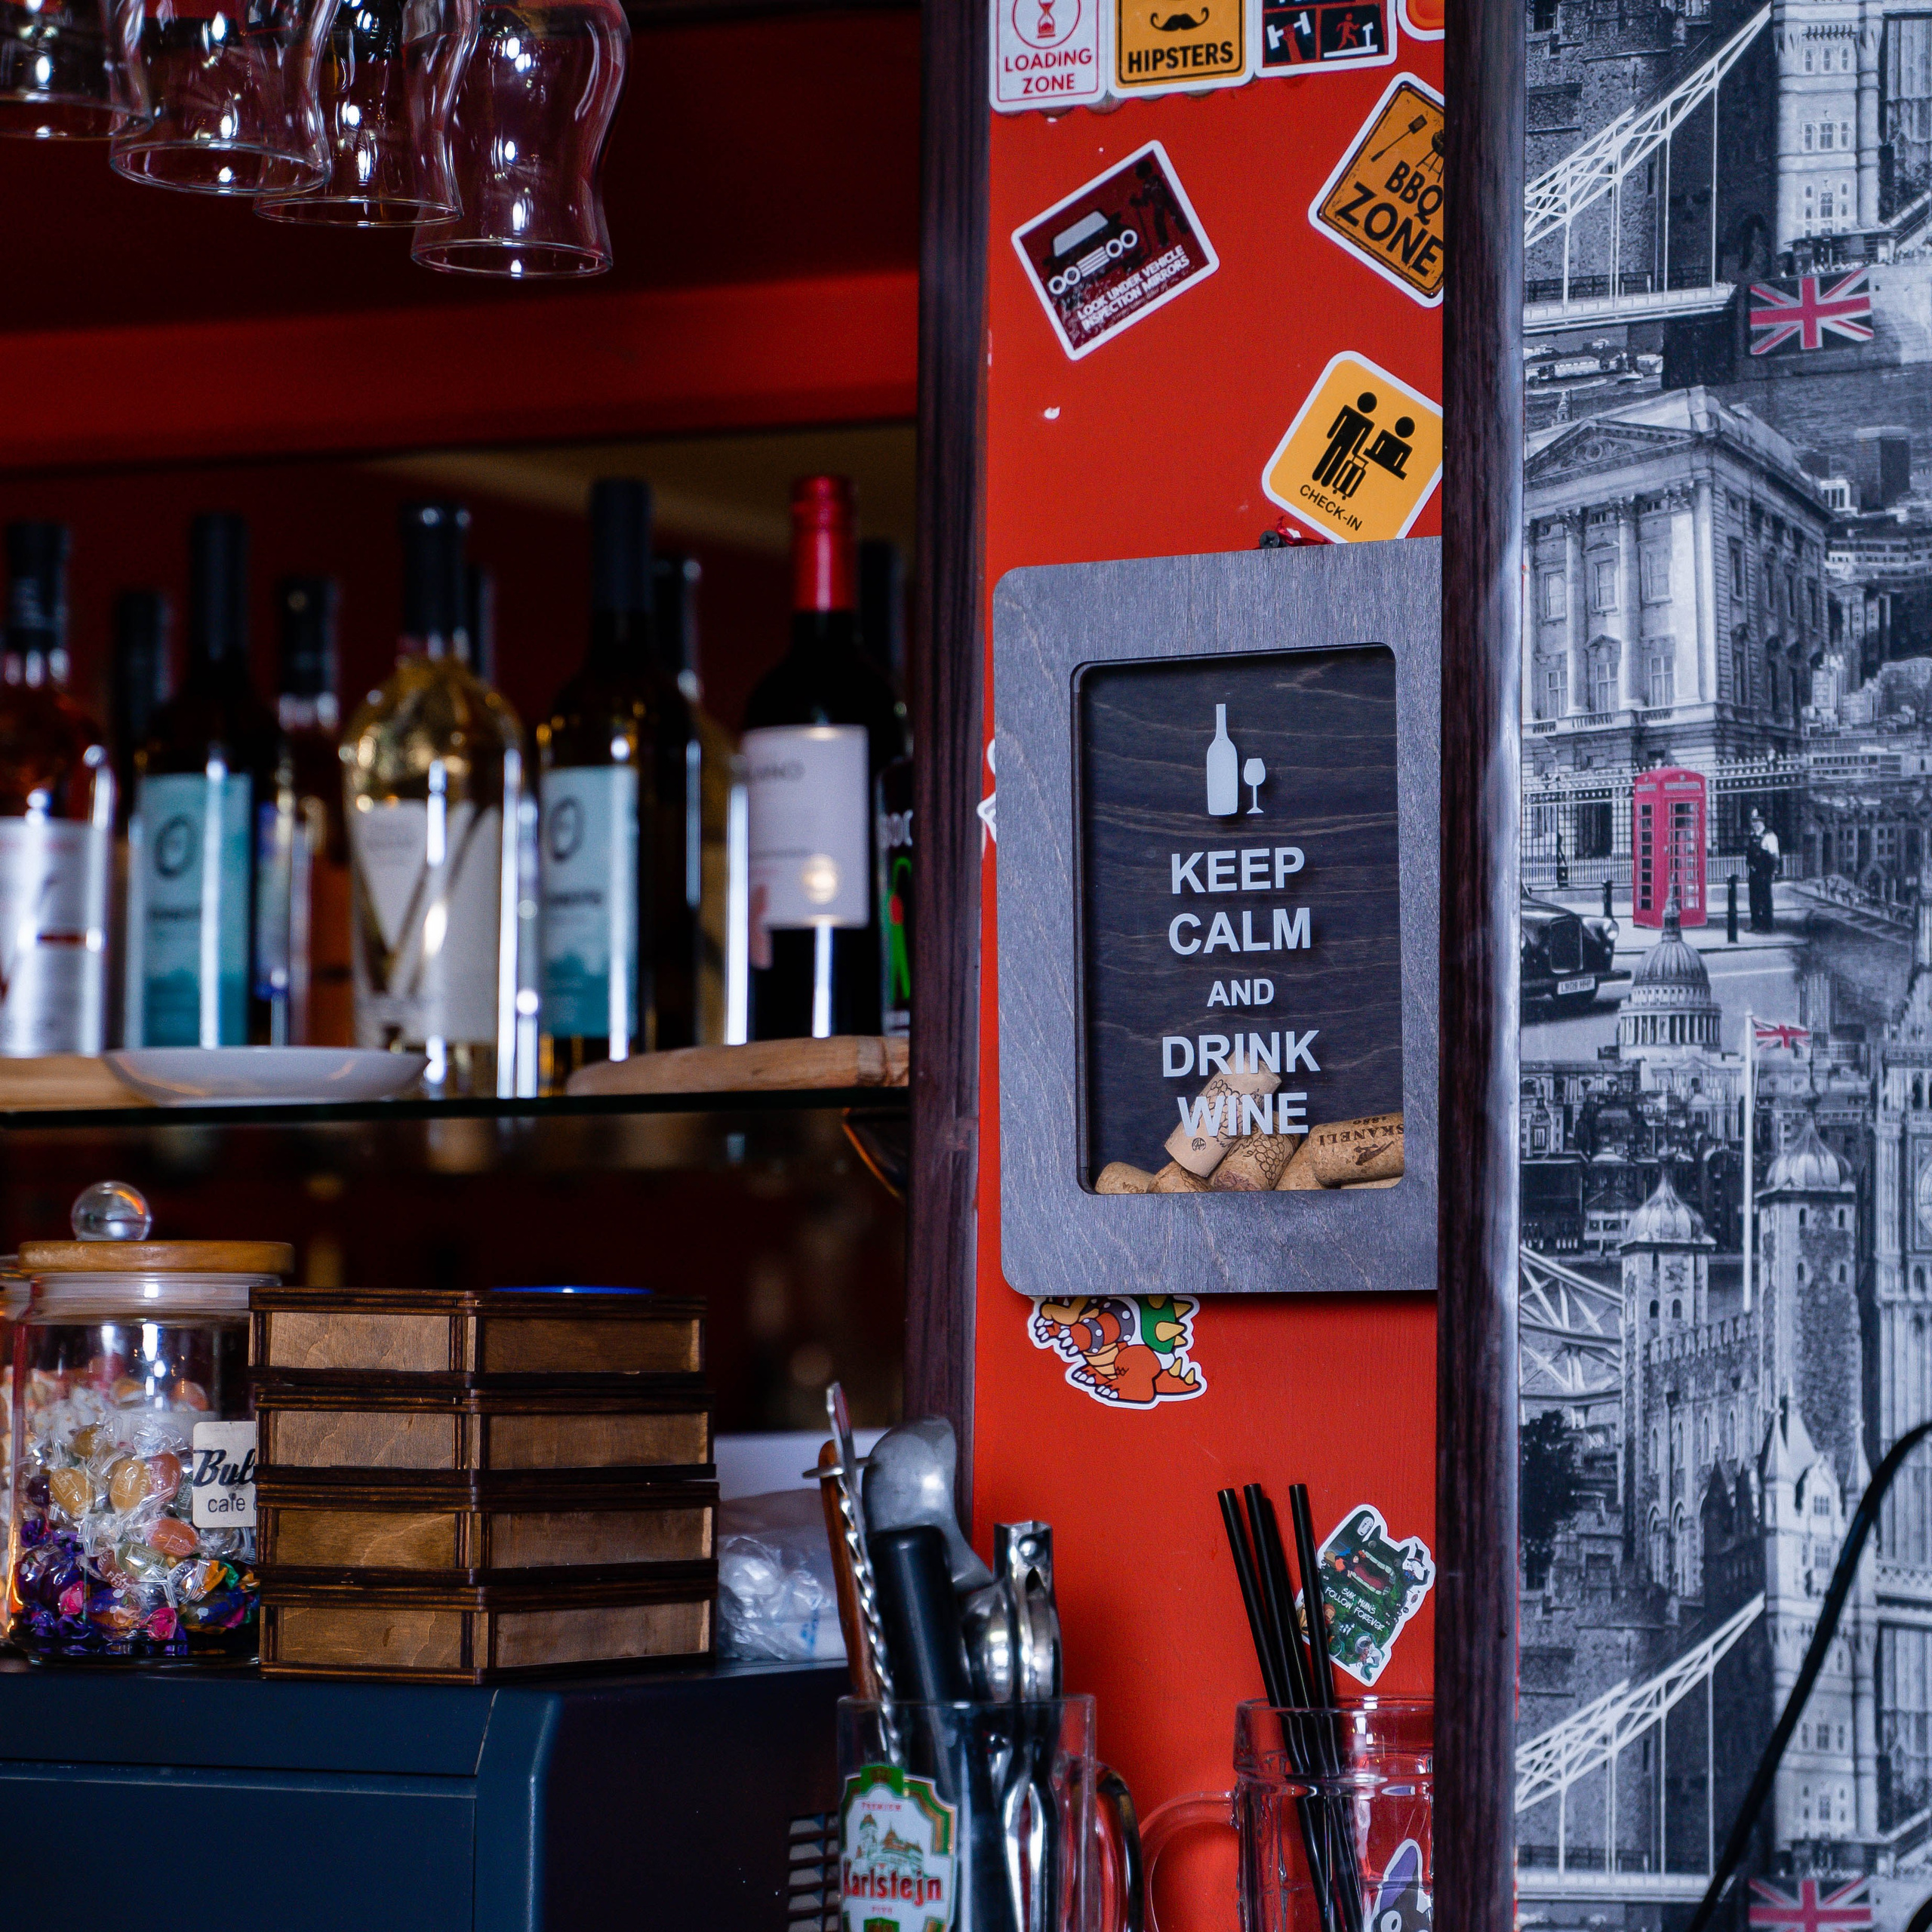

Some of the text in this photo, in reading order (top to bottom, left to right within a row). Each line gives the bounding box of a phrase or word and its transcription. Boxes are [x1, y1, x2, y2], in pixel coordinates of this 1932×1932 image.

[1004, 48, 1092, 73] LOADING
[1128, 41, 1234, 74] HIPSTERS
[1023, 73, 1075, 94] ZONE
[1384, 159, 1444, 226] BBQ
[1334, 181, 1444, 277] ZONE
[1077, 294, 1108, 319] LOOK
[1106, 272, 1143, 300] UNDER
[1141, 245, 1186, 277] VEHICLE
[1081, 287, 1143, 331] INSPECTION
[1142, 254, 1190, 293] MIRRORS
[1300, 485, 1363, 531] CHECK-IN
[1171, 847, 1306, 894] KEEP
[1168, 907, 1312, 955] CALM
[1207, 979, 1275, 1007] AND
[1162, 1030, 1321, 1078] DRINK
[1177, 1092, 1309, 1137] WINE
[1324, 1586, 1386, 1632] FOLLOW FOREVER
[843, 1859, 943, 1907] Karlstejn
